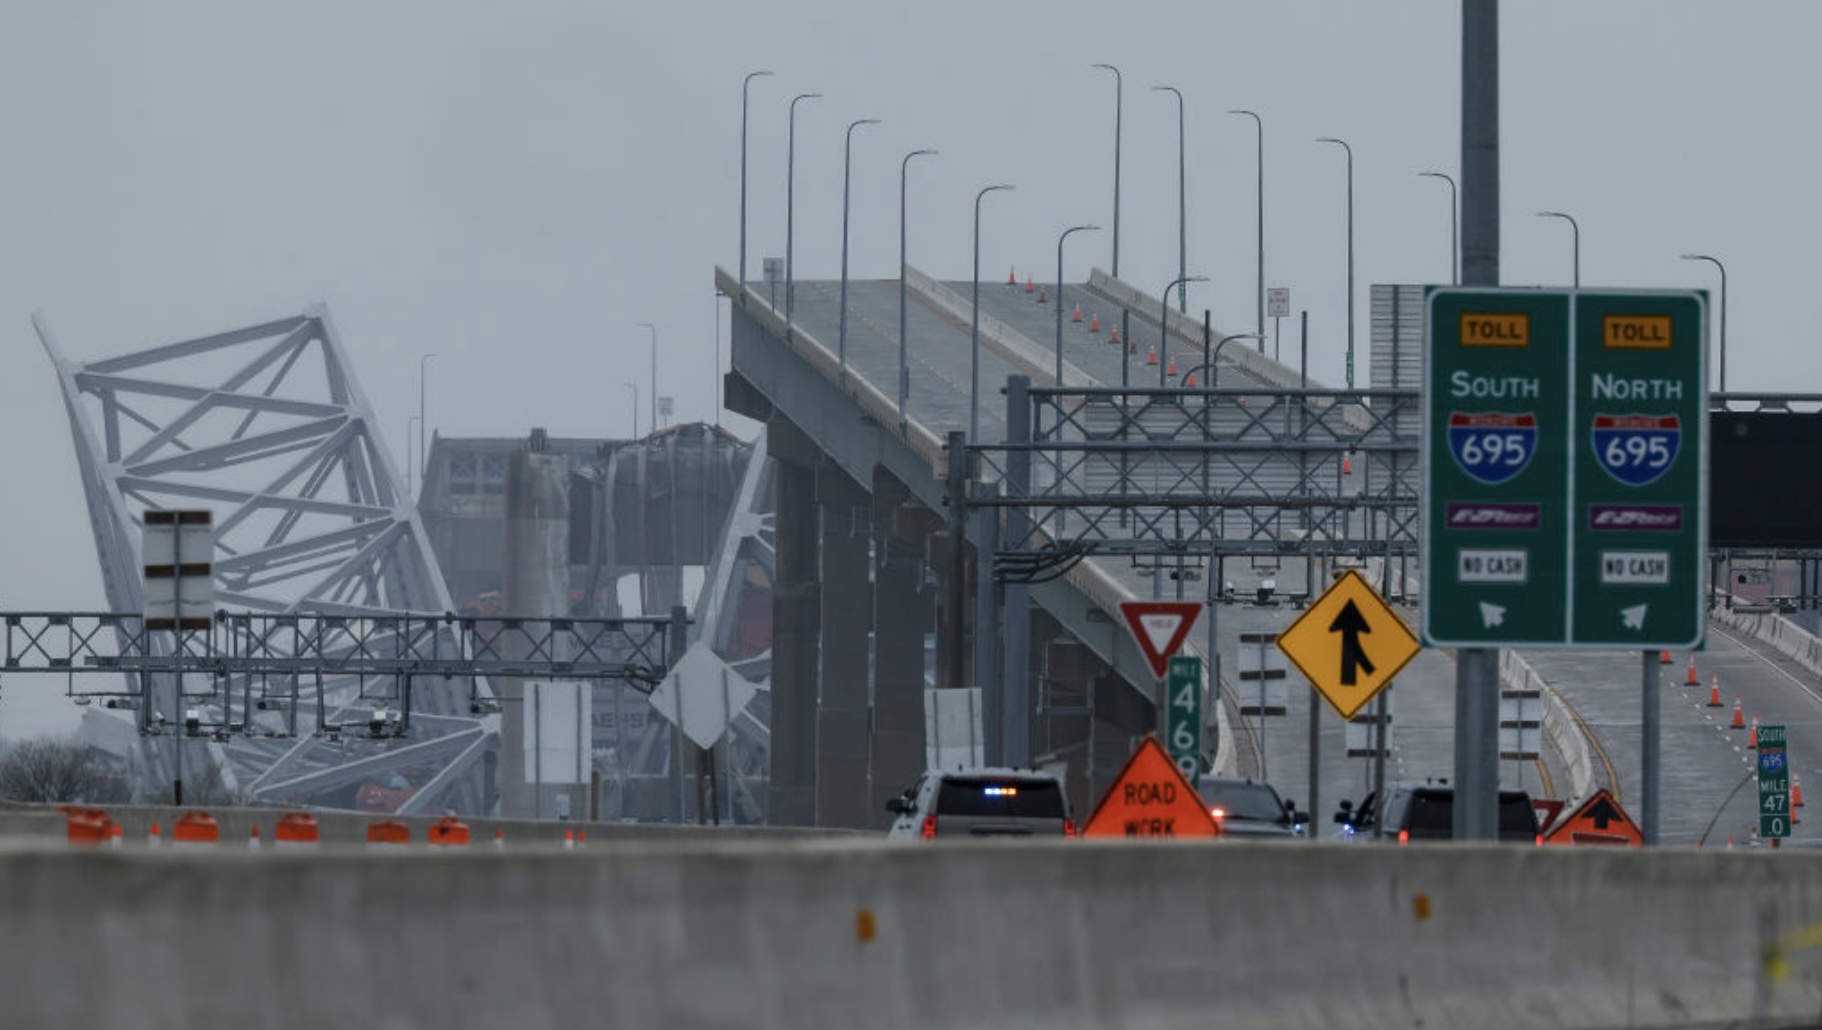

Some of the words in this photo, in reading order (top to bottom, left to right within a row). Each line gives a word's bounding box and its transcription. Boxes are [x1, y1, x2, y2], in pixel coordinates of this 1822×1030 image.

[1467, 321, 1521, 339] TOLL
[1610, 323, 1664, 341] TOLL
[1451, 371, 1539, 398] SOUTH
[1591, 373, 1682, 400] NORTH
[1461, 433, 1526, 466] 695
[1605, 435, 1670, 468] 695
[1463, 556, 1483, 575] NO
[1486, 556, 1523, 575] CASH
[1605, 558, 1625, 577] NO
[1628, 558, 1665, 577] CASH
[1757, 727, 1787, 743] SOUTH
[1124, 781, 1177, 806] ROAD
[1760, 779, 1787, 793] MILE
[1764, 794, 1786, 812] 47
